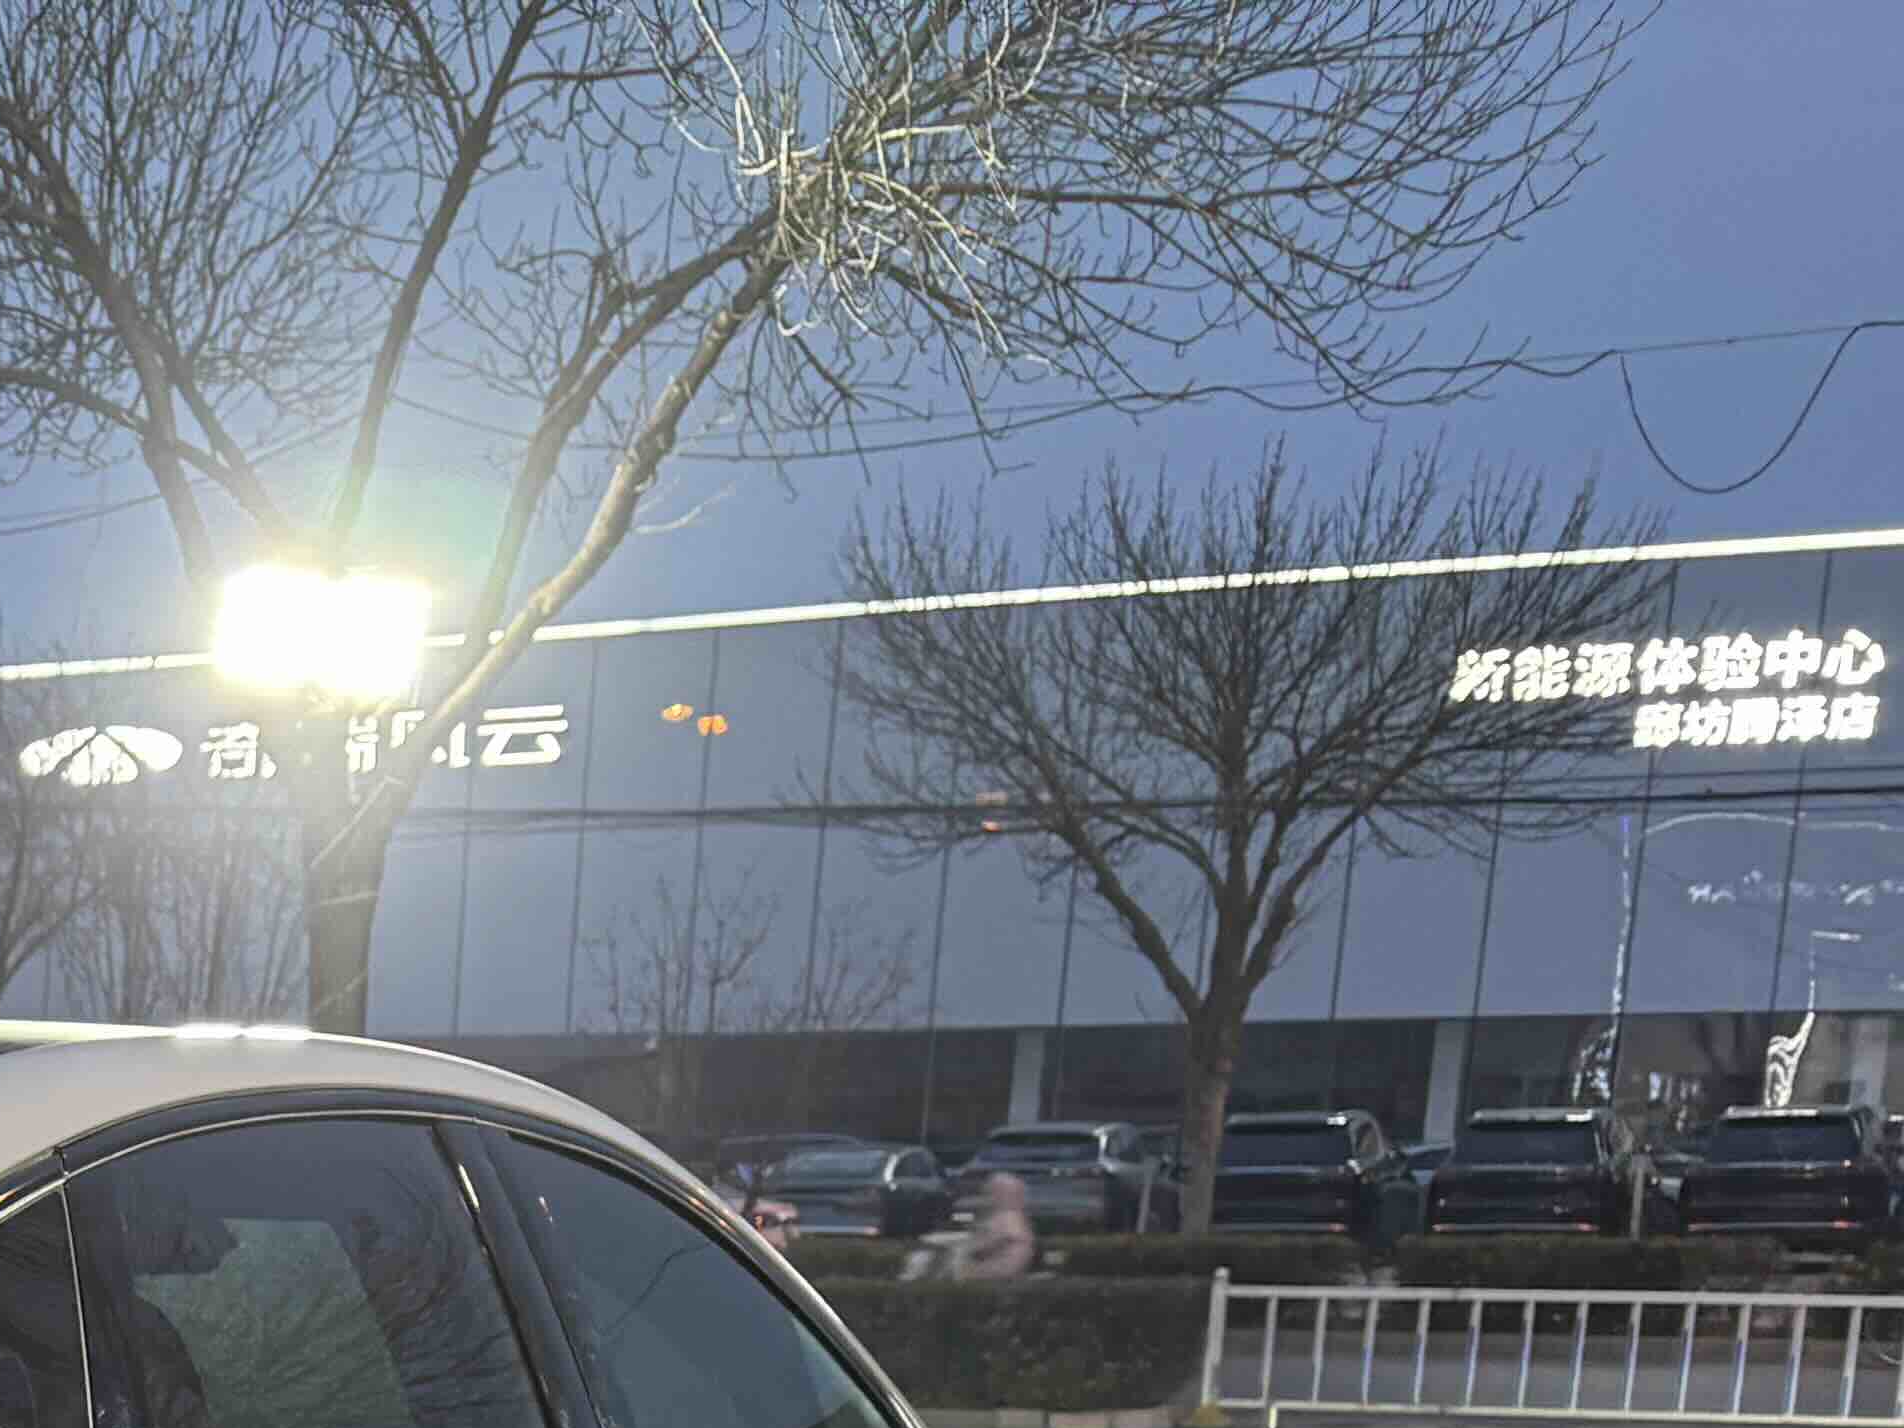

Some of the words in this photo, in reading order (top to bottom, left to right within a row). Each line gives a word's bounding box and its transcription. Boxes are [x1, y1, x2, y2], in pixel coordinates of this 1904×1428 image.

[1449, 628, 1886, 703] 新能源体验中心
